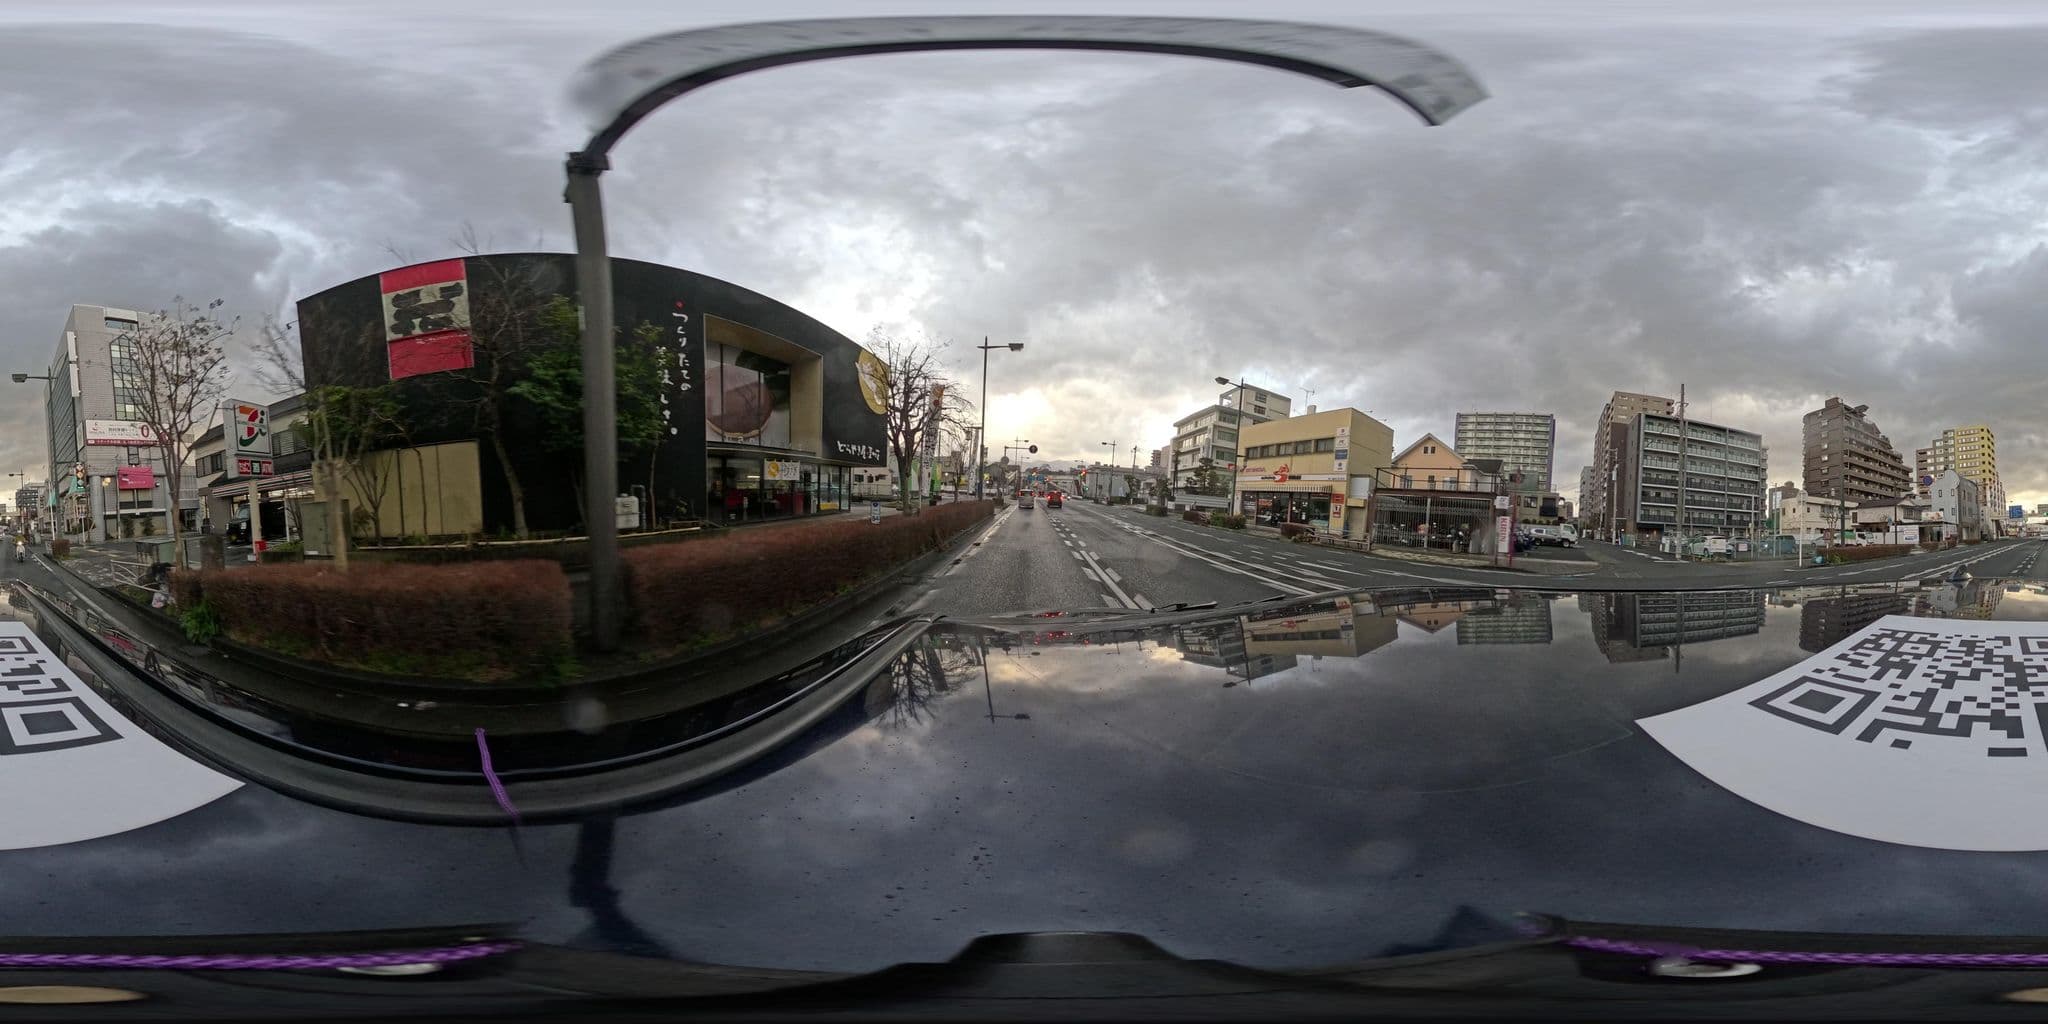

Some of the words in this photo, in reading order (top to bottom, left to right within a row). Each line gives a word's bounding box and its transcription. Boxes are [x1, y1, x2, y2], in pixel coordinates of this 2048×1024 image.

[672, 312, 692, 391] つくりたての
[1500, 517, 1508, 543] KIRIN
